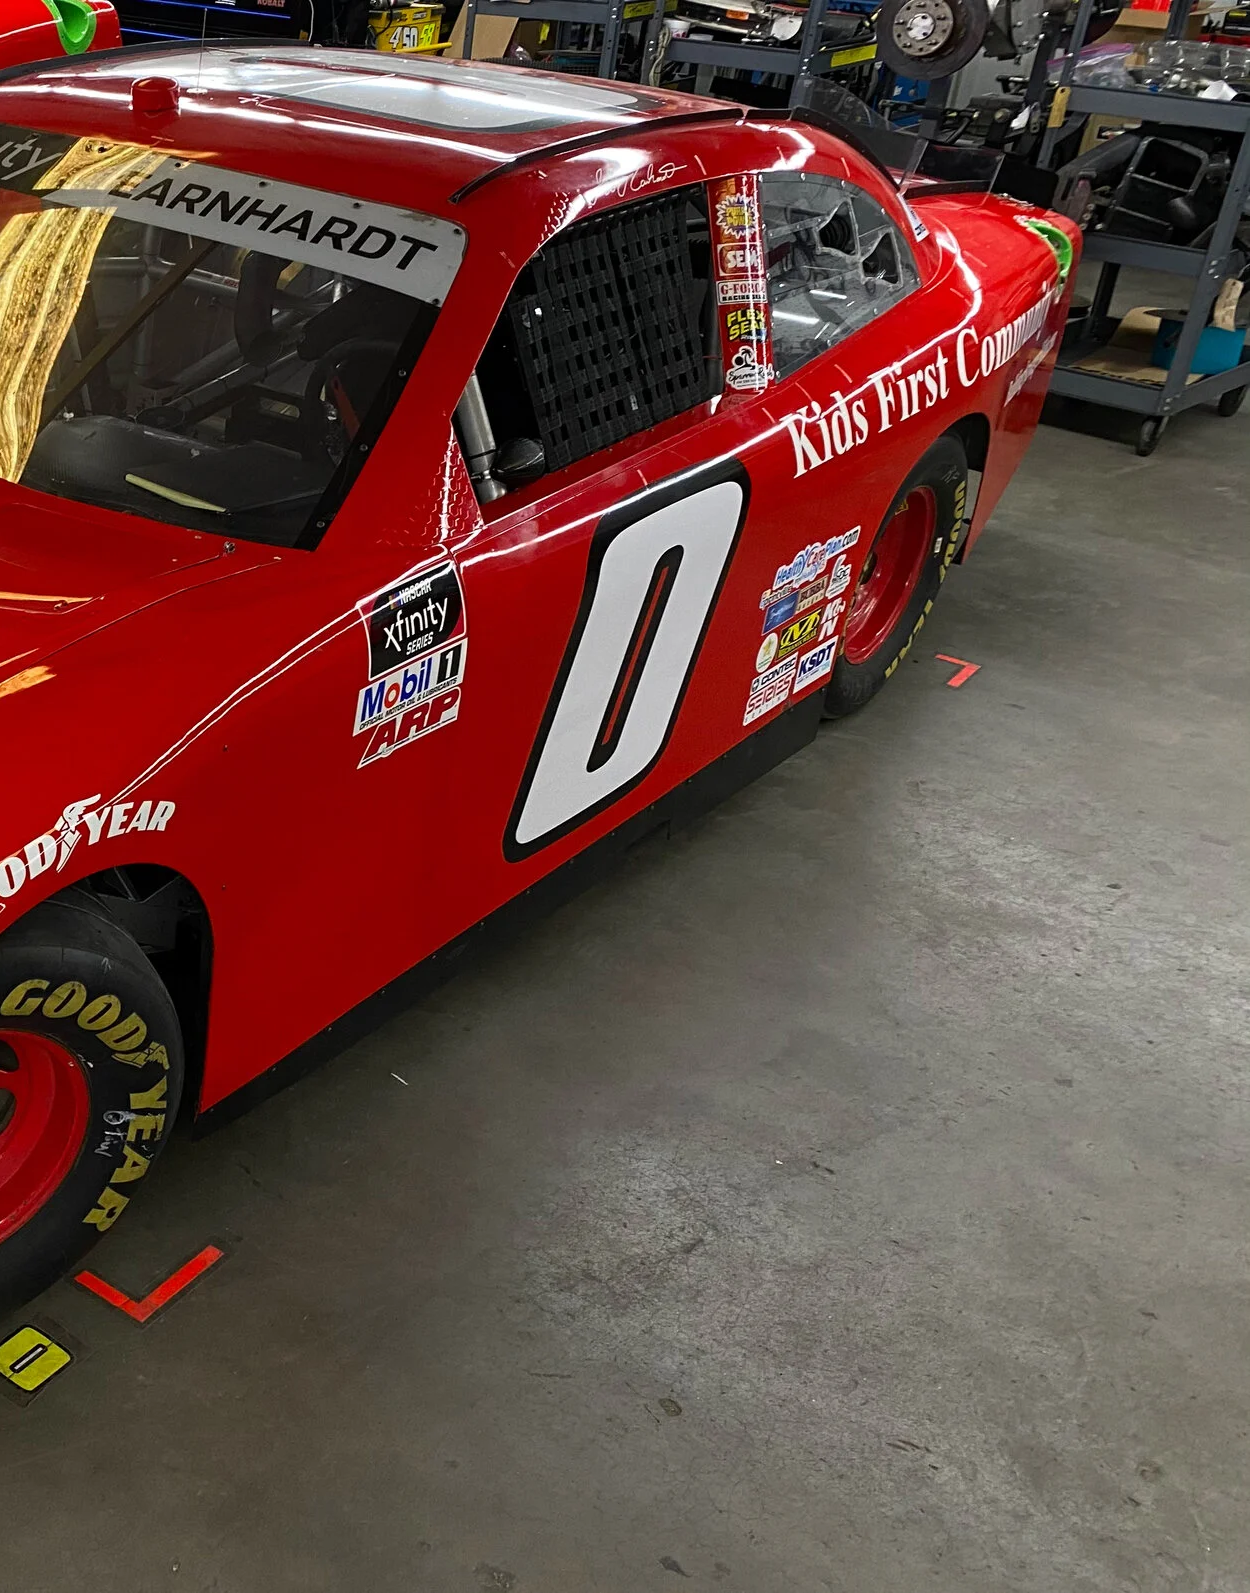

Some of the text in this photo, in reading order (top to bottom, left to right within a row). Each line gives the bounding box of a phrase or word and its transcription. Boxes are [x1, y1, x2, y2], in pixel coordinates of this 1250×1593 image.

[109, 165, 438, 271] EARNHARDT
[780, 391, 869, 479] Kids
[867, 346, 950, 433] First
[383, 597, 448, 652] xfinity
[406, 631, 434, 656] SERIES
[361, 657, 433, 722] Mobil
[507, 470, 746, 855] 0
[798, 641, 836, 678] KSDT
[359, 712, 384, 731] OFFICIAL
[385, 701, 406, 717] MOTOR
[363, 689, 460, 760] ARP
[0, 978, 173, 1232] GOODYEAR
